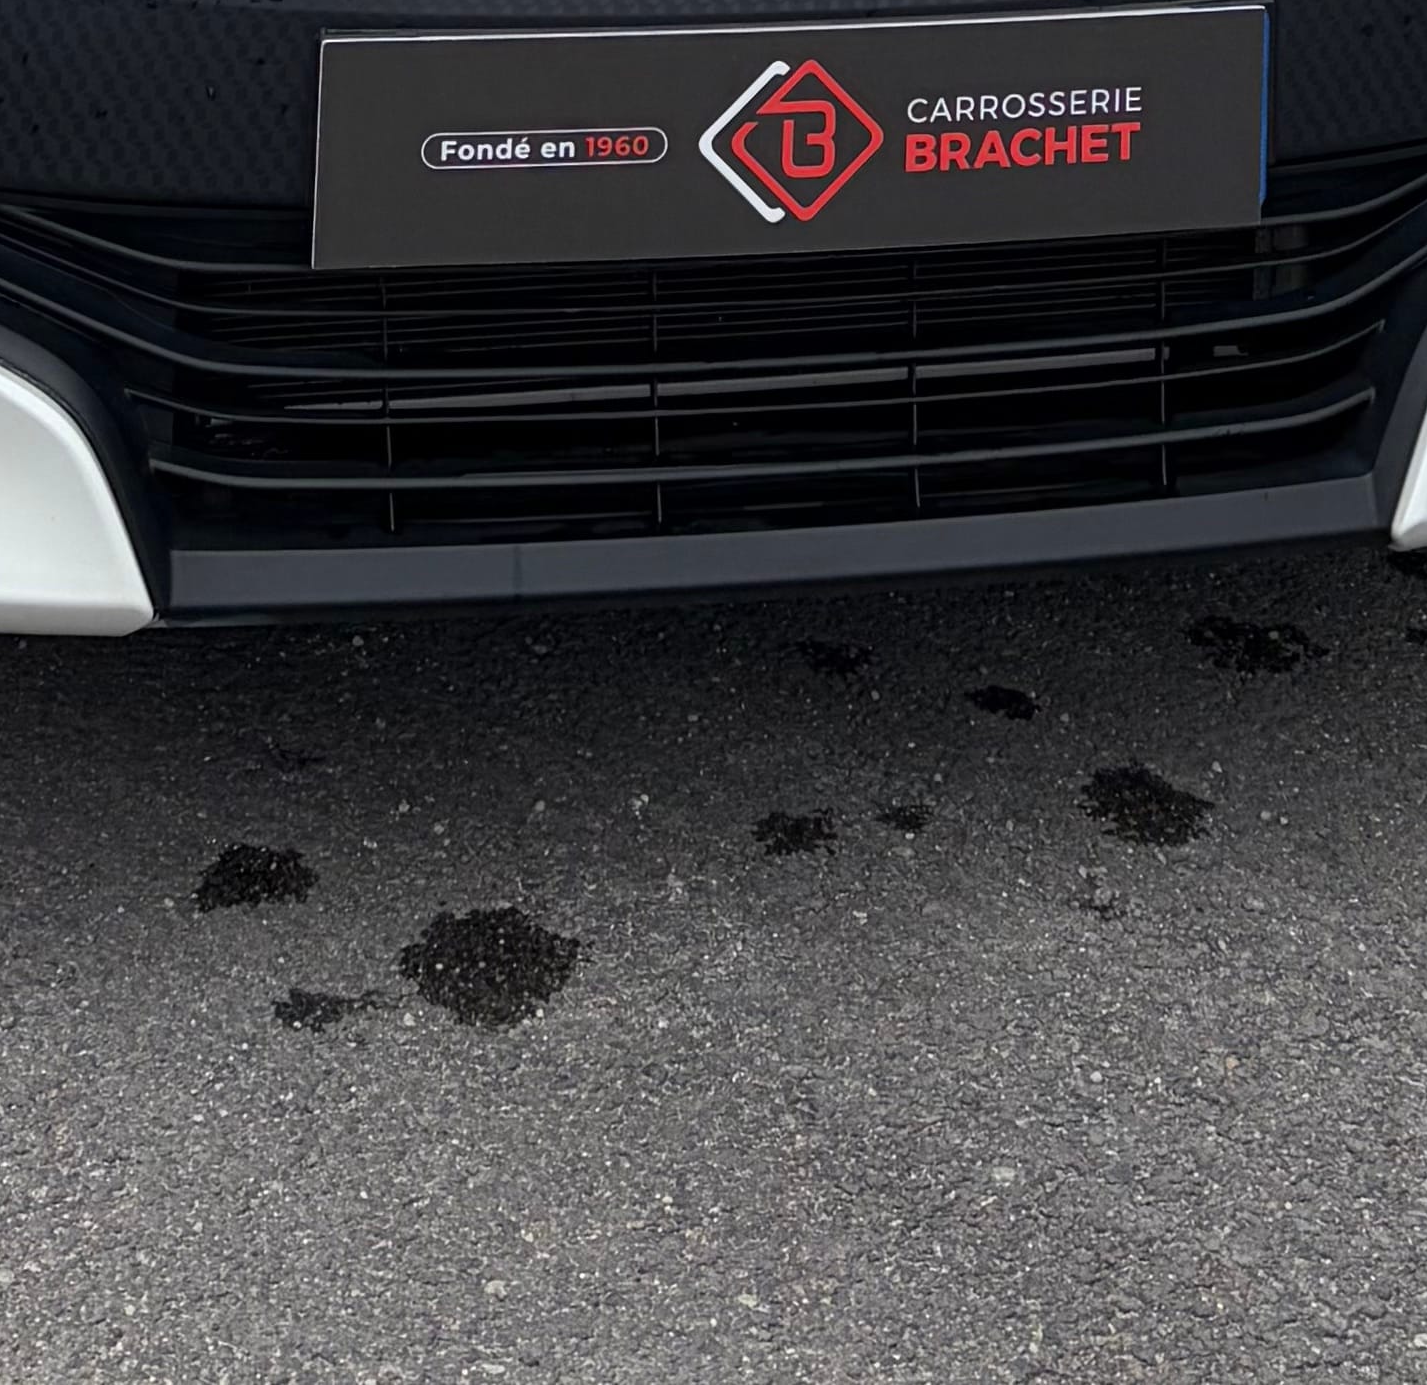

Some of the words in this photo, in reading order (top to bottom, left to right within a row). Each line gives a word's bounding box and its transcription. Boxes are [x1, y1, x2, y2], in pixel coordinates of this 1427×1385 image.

[906, 86, 1143, 124] CARROSSERIE
[440, 136, 531, 162] Fondé
[540, 140, 576, 159] en
[585, 134, 649, 157] 1960
[905, 121, 1141, 173] BRACHET
